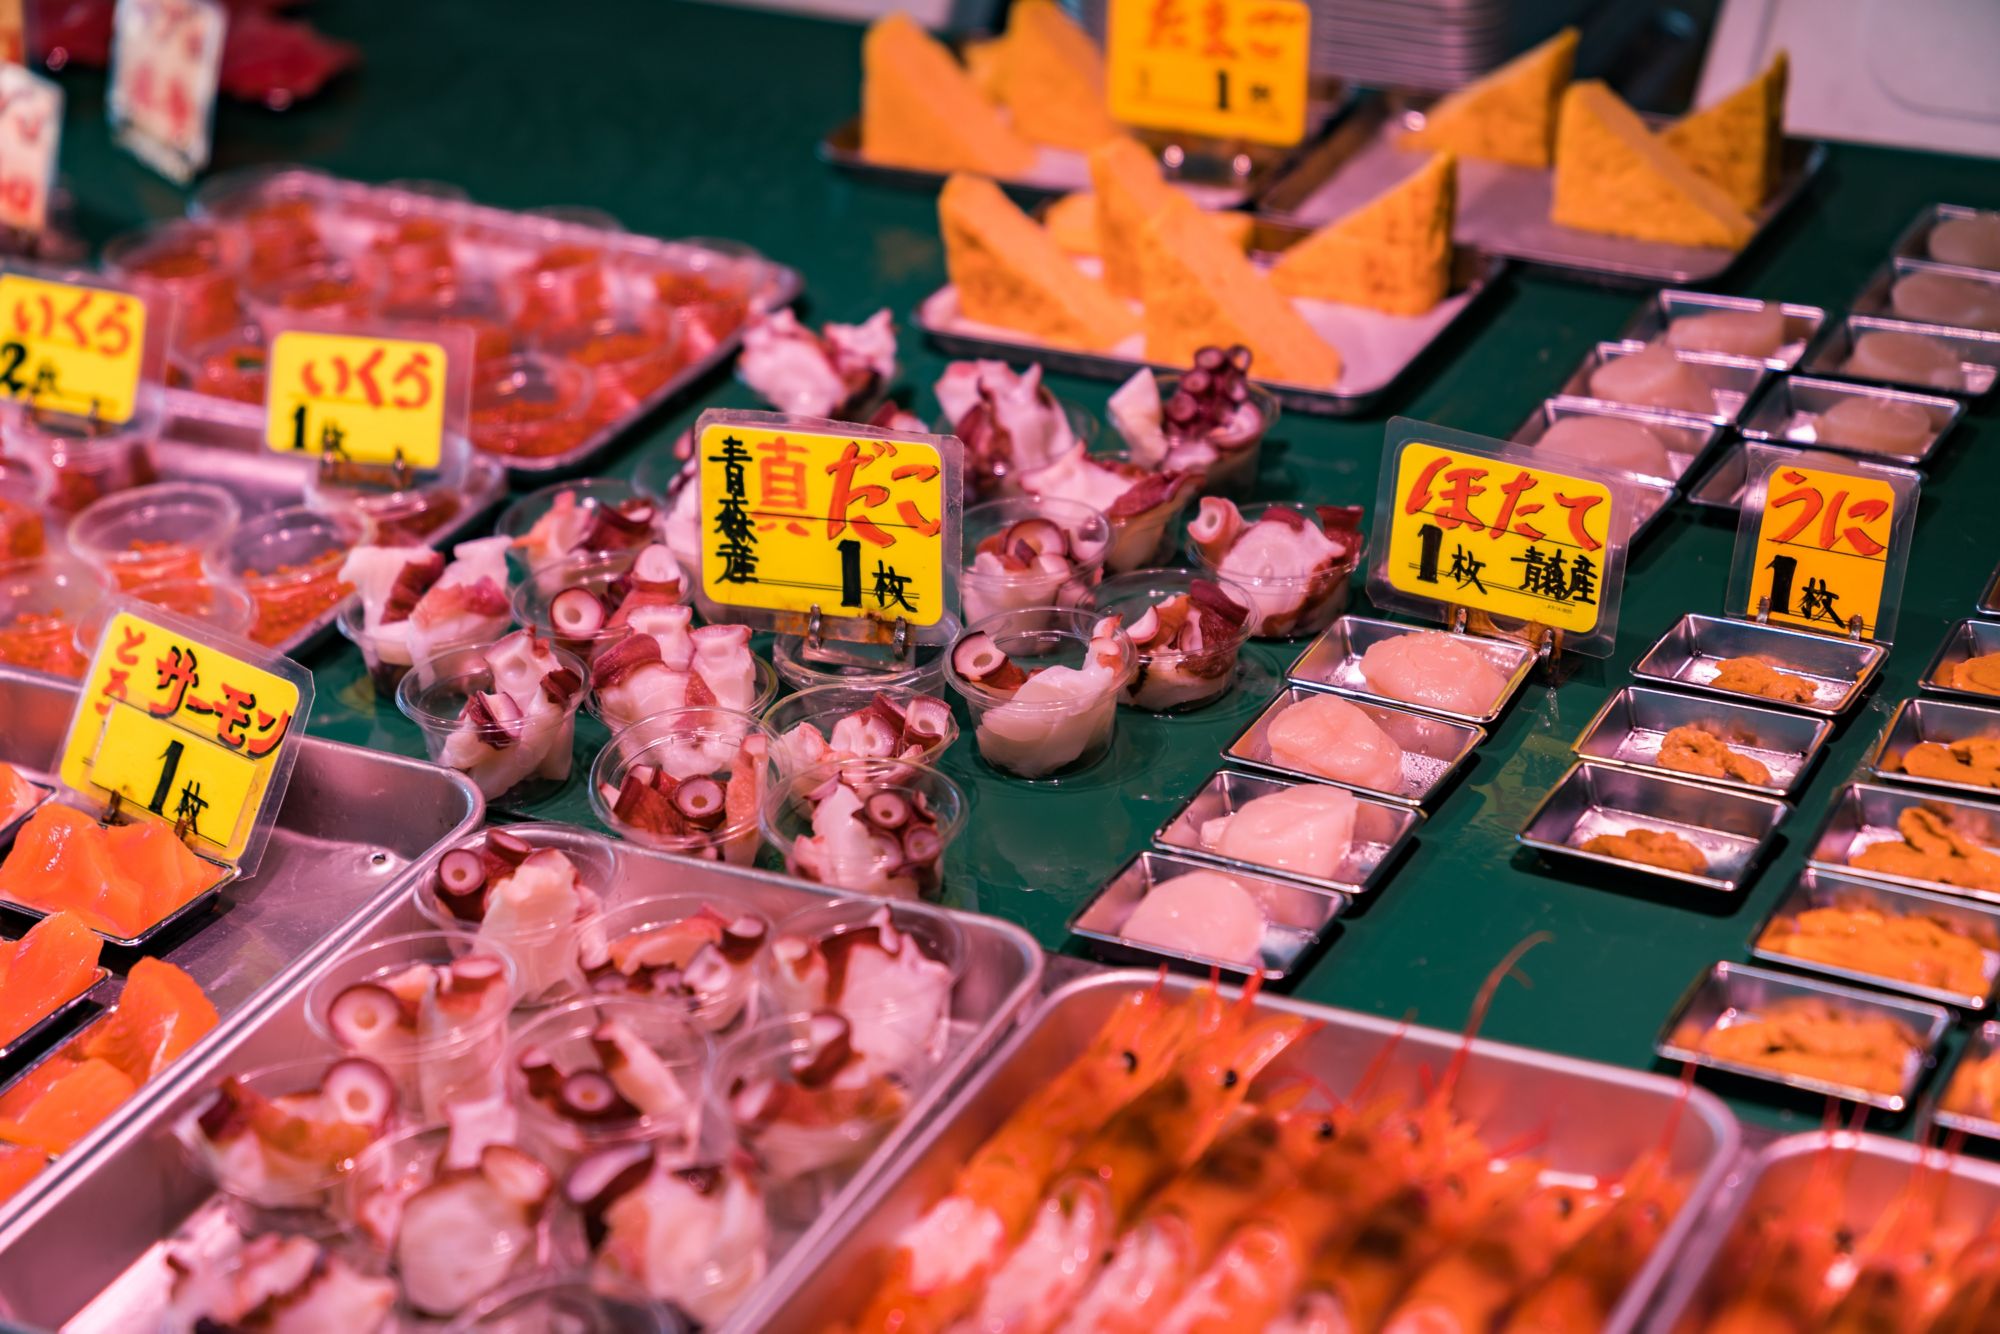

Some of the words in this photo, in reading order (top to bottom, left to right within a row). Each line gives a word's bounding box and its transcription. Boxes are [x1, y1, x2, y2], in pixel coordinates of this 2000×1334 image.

[14, 290, 131, 358] いくら
[301, 347, 432, 410] いくら
[1405, 456, 1604, 552] ほたて
[1770, 471, 1889, 556] うに
[837, 539, 918, 613] 1枚
[1417, 523, 1488, 595] 1枚
[1765, 554, 1846, 629] 1枚
[148, 646, 292, 759] サーモン
[148, 739, 209, 834] 1枚
